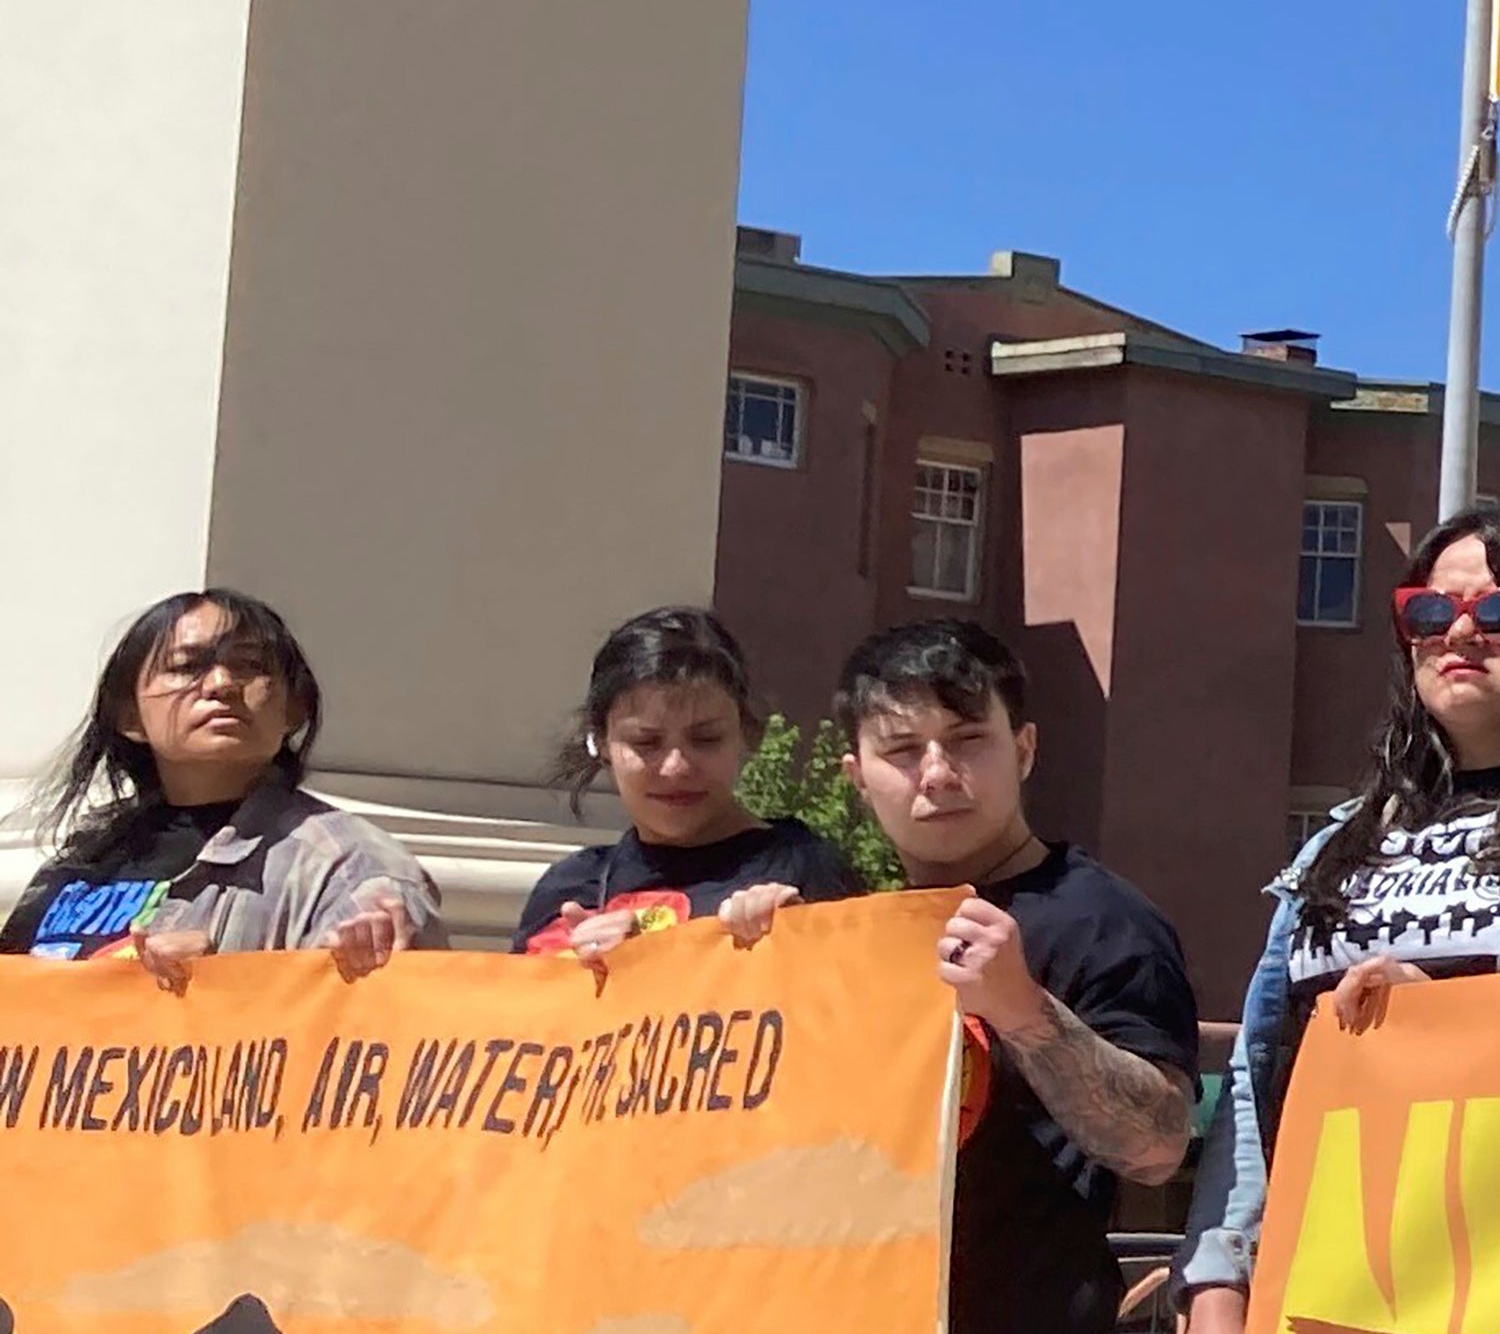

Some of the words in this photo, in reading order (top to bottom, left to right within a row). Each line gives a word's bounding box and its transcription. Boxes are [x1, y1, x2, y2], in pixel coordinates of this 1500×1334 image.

[39, 1042, 207, 1137] MEXICO
[301, 1035, 390, 1147] AIR,
[614, 1009, 784, 1119] SACRED
